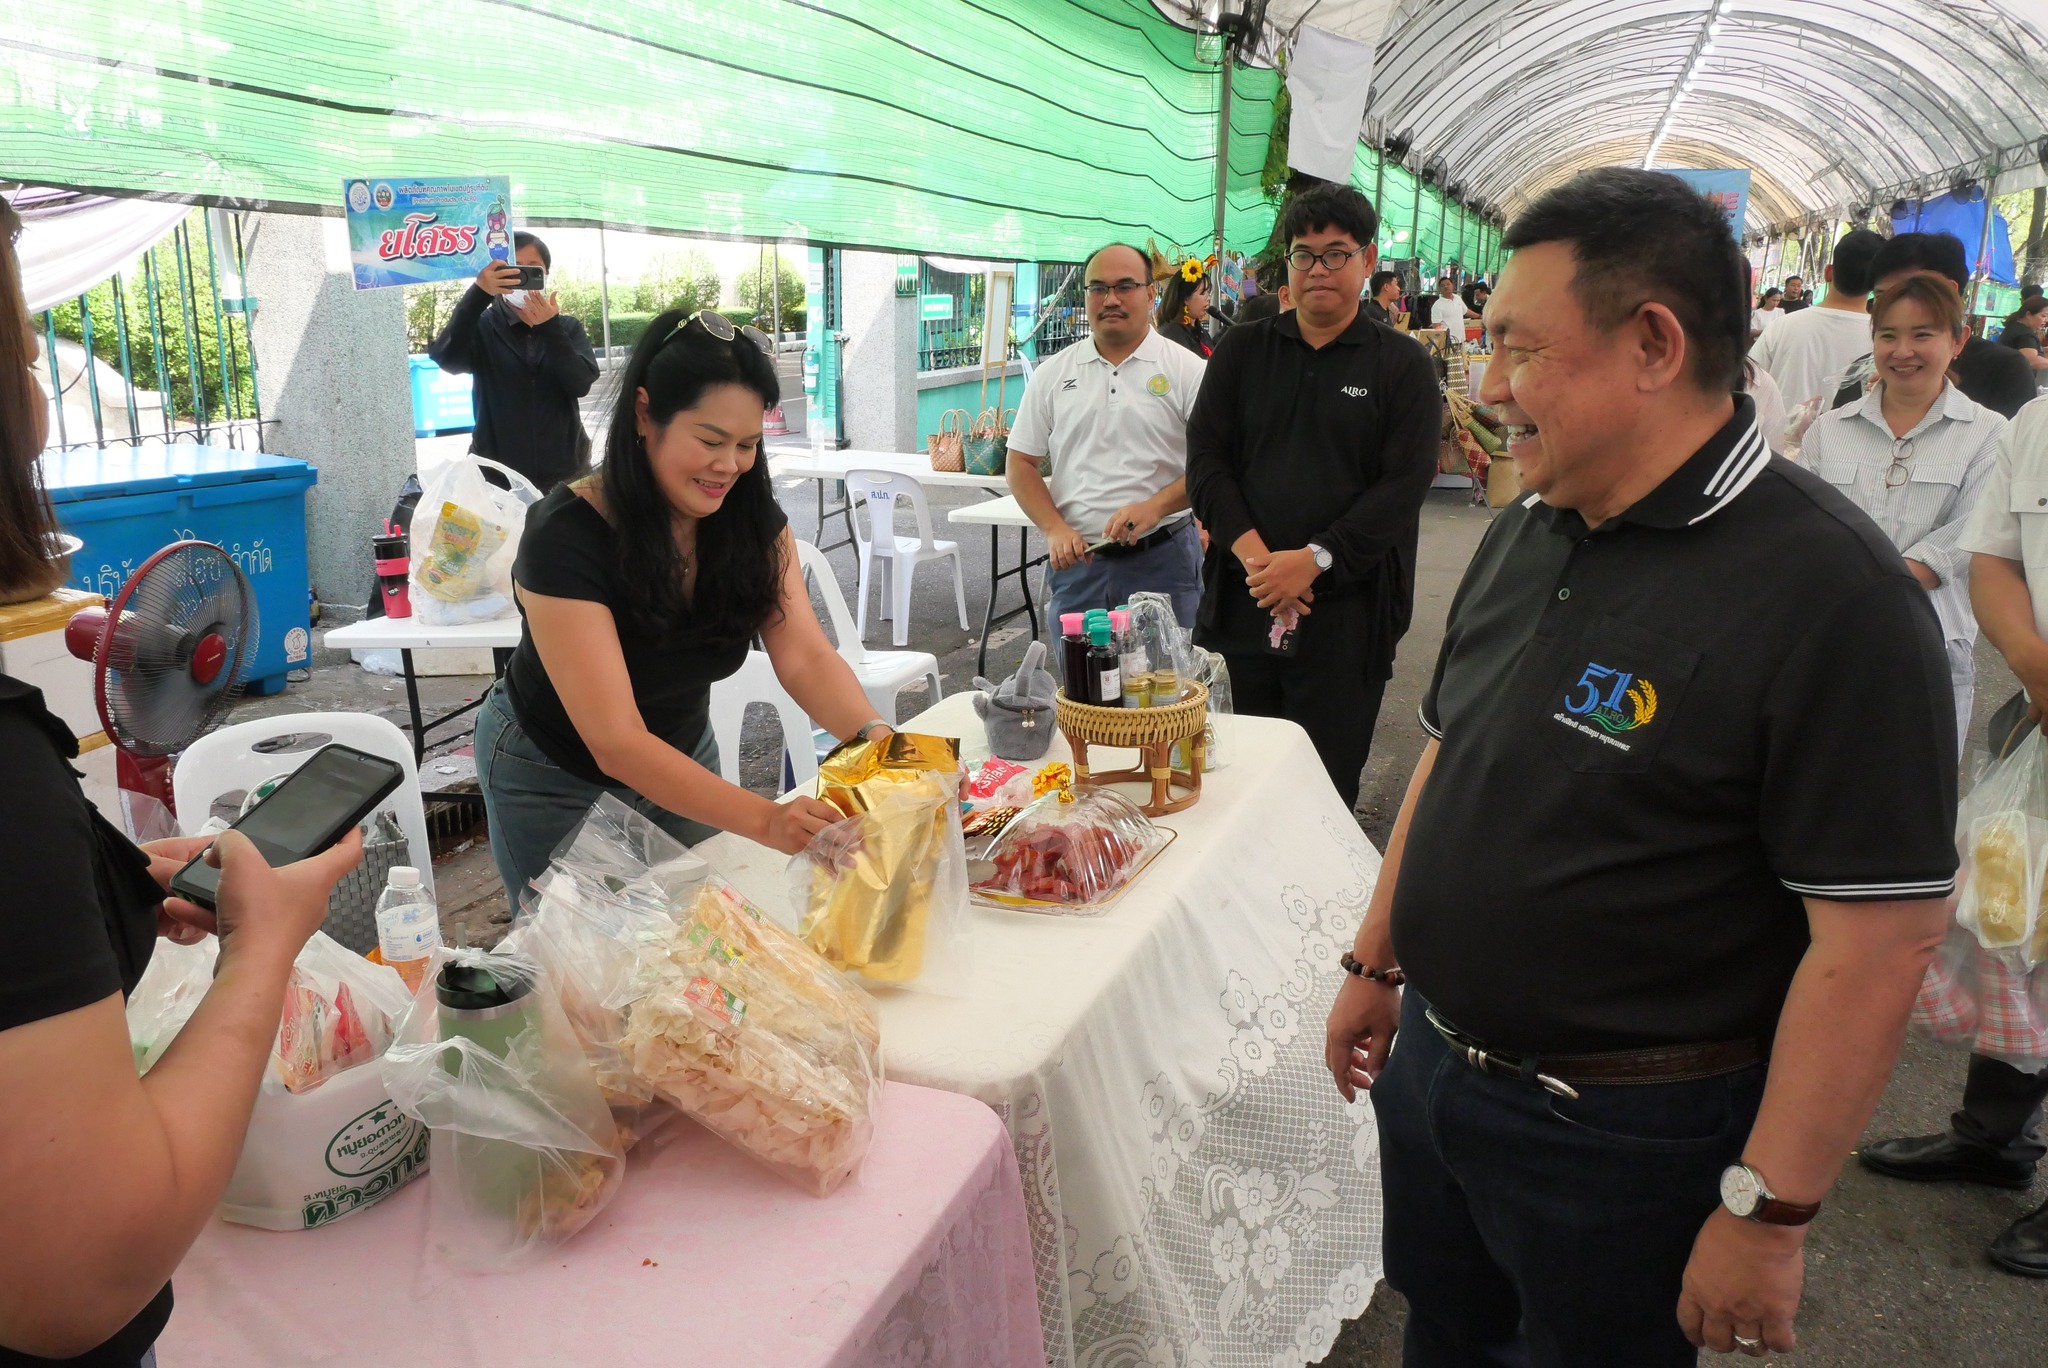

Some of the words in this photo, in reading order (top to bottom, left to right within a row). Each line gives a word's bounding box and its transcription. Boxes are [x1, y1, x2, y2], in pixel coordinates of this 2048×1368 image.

[378, 212, 479, 261] ยโสธร
[897, 274, 918, 292] OUT
[1340, 385, 1368, 398] ALRO
[1564, 662, 1634, 714] 51
[1594, 706, 1625, 724] ALRO
